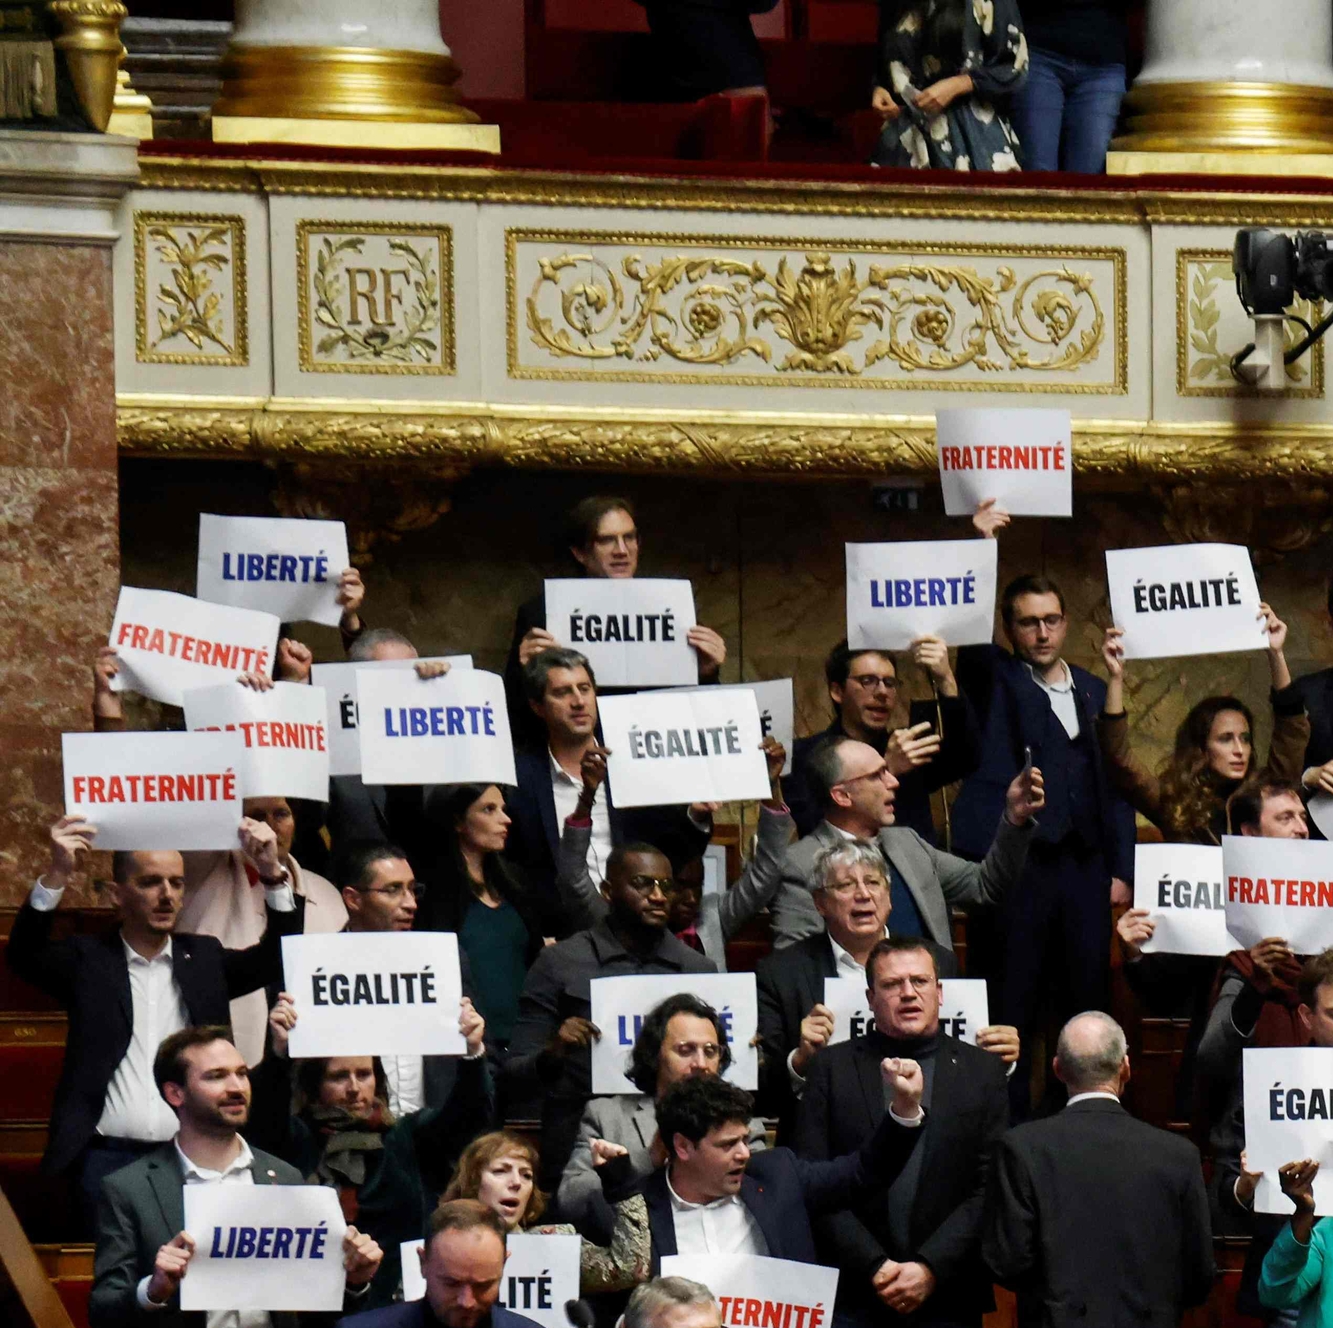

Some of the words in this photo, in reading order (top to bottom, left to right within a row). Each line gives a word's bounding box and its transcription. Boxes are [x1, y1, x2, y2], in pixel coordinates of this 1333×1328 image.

[345, 267, 411, 326] RF
[941, 440, 1065, 472] FRATERNITÉ
[222, 550, 328, 583] LIBERTÉ
[870, 569, 976, 608] LIBERTÉ
[1133, 570, 1242, 614] ÉGALITÉ
[569, 608, 675, 642] ÉGALITÉ
[117, 622, 269, 674] FRATERNITÉ
[194, 720, 326, 752] TERNITÉ
[384, 701, 496, 737] LIBERTÉ
[628, 719, 743, 760] ÉGALITÉ
[72, 768, 236, 804] FRATERNITÉ
[1158, 874, 1225, 909] ÉGAL
[312, 965, 437, 1006] ÉGALITÉ
[210, 1221, 328, 1259] LIBERTÉ
